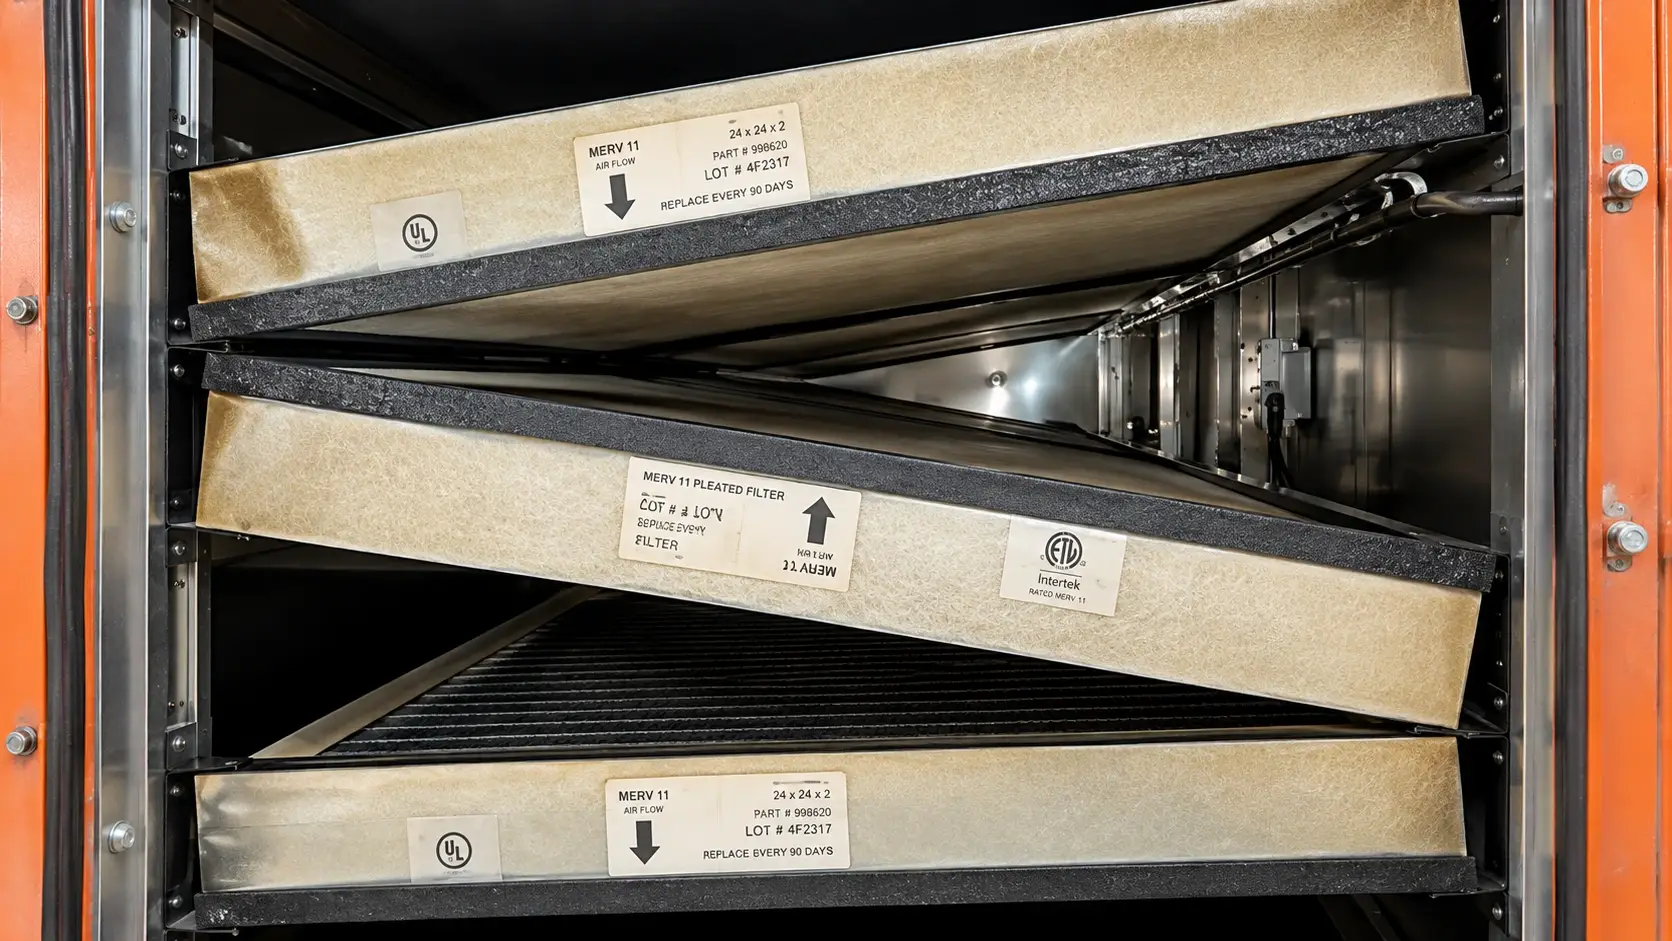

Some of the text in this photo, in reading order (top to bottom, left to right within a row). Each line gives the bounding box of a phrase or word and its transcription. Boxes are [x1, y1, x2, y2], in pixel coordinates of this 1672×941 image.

[729, 121, 786, 139] 24 x 24 x 2
[589, 140, 640, 158] MERV 11
[713, 139, 788, 161] PART # 998620
[595, 157, 636, 171] AIR FLOW
[704, 156, 790, 181] LOT # 4F2317
[660, 180, 794, 211] REPLACE EVERY 90 DAYS
[410, 223, 430, 243] UL
[643, 471, 785, 501] MERV 11 PLEATED FILTER
[1038, 573, 1080, 590] Intertek
[618, 790, 669, 801] MERV 11
[773, 790, 786, 800] 24
[798, 789, 812, 799] 24
[823, 789, 831, 799] 2
[754, 808, 832, 819] PART # 998620
[745, 824, 832, 837] LOT # 4F2317
[445, 840, 464, 861] UL
[703, 849, 750, 860] REPLACE
[789, 847, 802, 856] 90
[805, 846, 834, 856] DAYS
